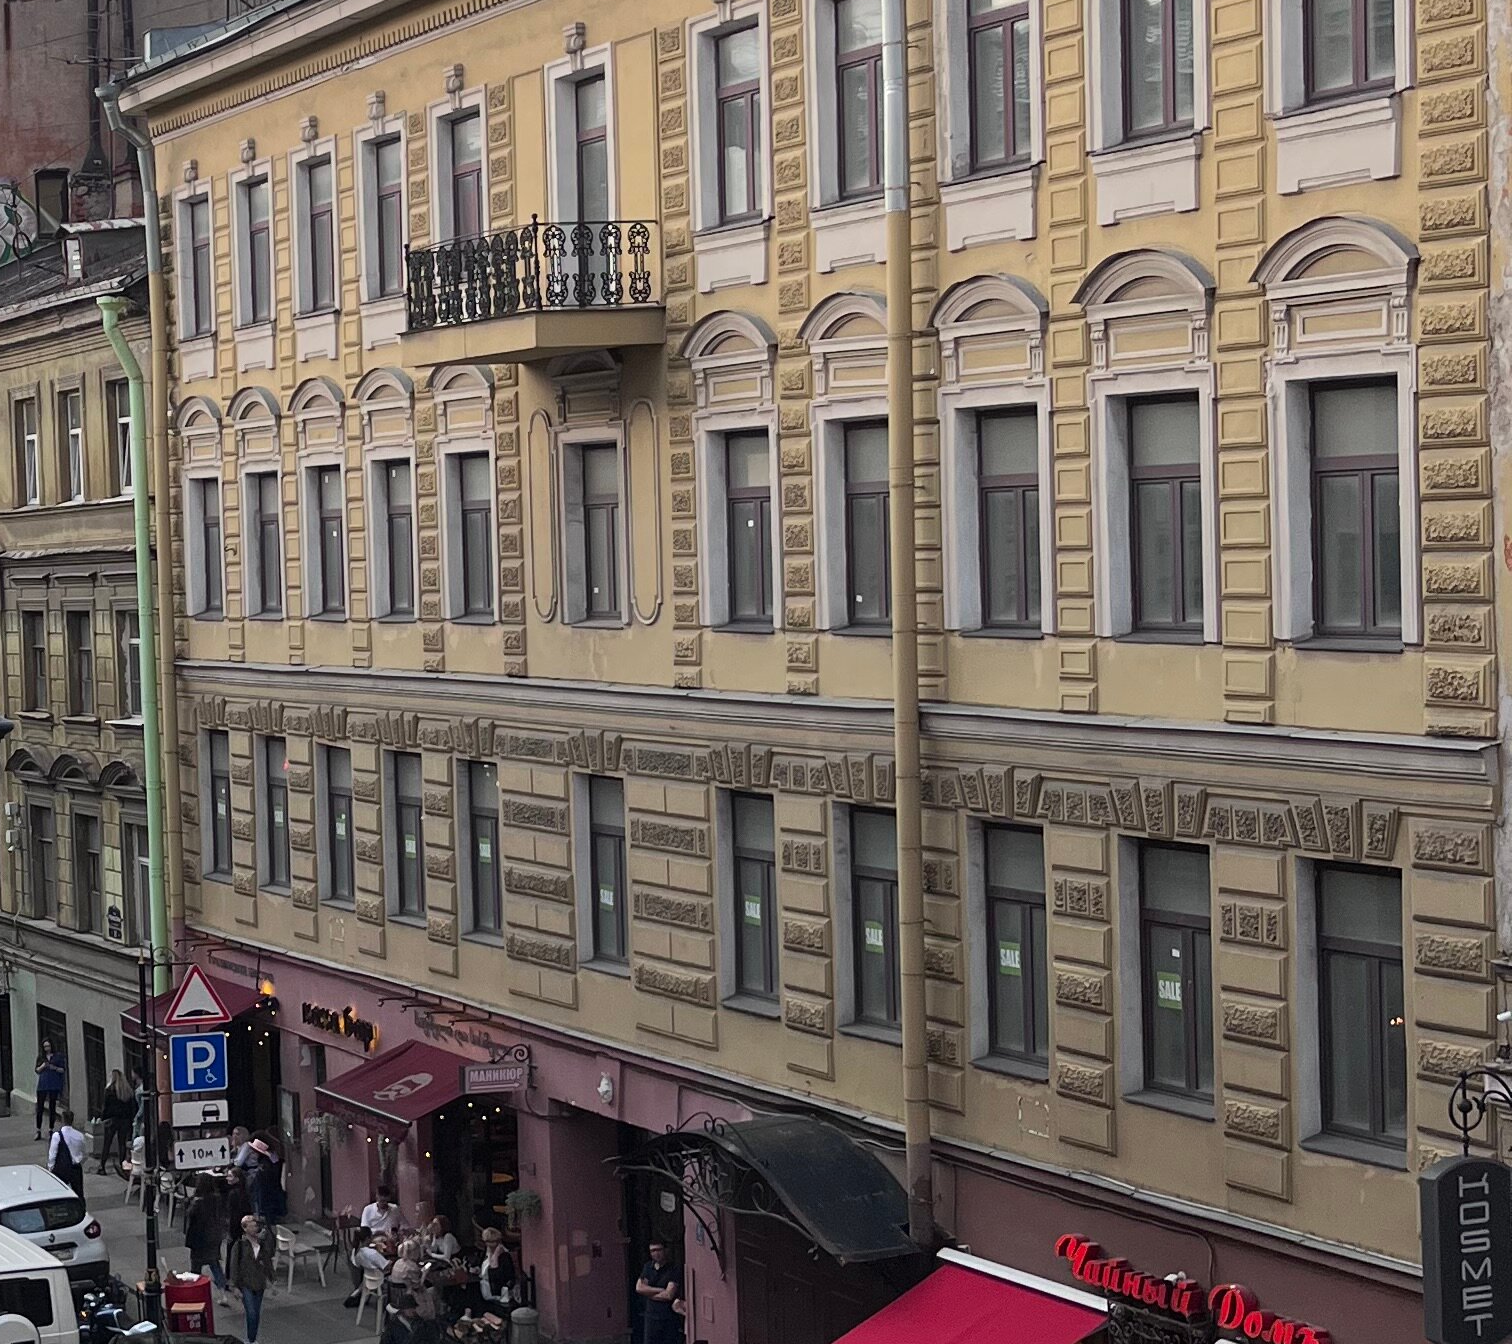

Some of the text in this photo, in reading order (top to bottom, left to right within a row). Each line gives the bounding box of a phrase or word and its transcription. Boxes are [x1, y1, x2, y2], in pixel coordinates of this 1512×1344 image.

[186, 1040, 216, 1085] P
[469, 1067, 523, 1083] МАНИКЮР
[1054, 1232, 1198, 1315] Чайный
[1458, 1171, 1494, 1337] KOSMET
